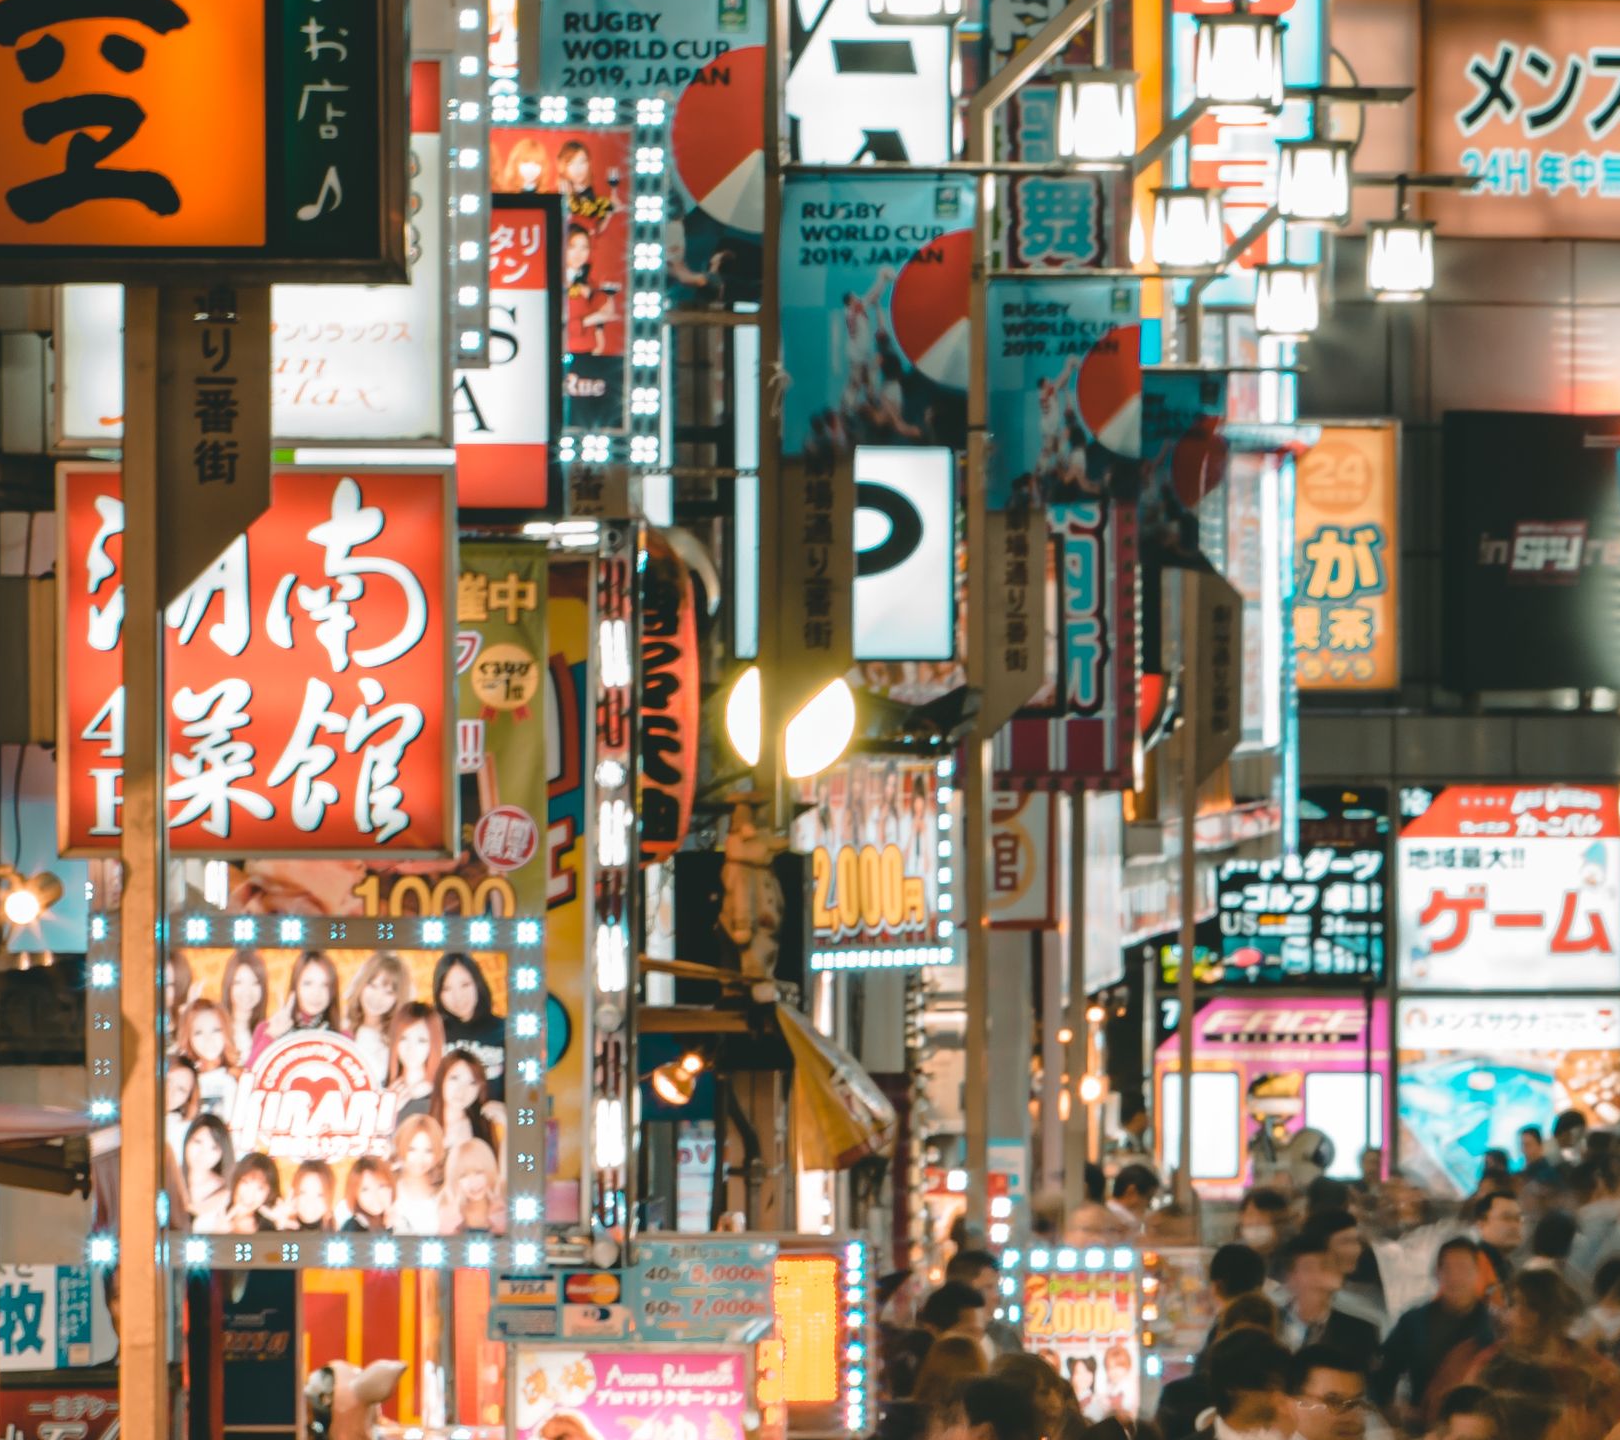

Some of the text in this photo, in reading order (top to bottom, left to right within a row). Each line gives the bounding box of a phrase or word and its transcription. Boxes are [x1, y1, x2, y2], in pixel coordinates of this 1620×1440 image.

[563, 11, 663, 36] RUGBY
[563, 40, 731, 62] WORLD CUP
[638, 65, 732, 89] JAPAN
[800, 201, 885, 221] RUGBY
[800, 224, 944, 243] WORLD CUP
[867, 247, 944, 267] JAPAN
[1418, 884, 1614, 955] ゲーム
